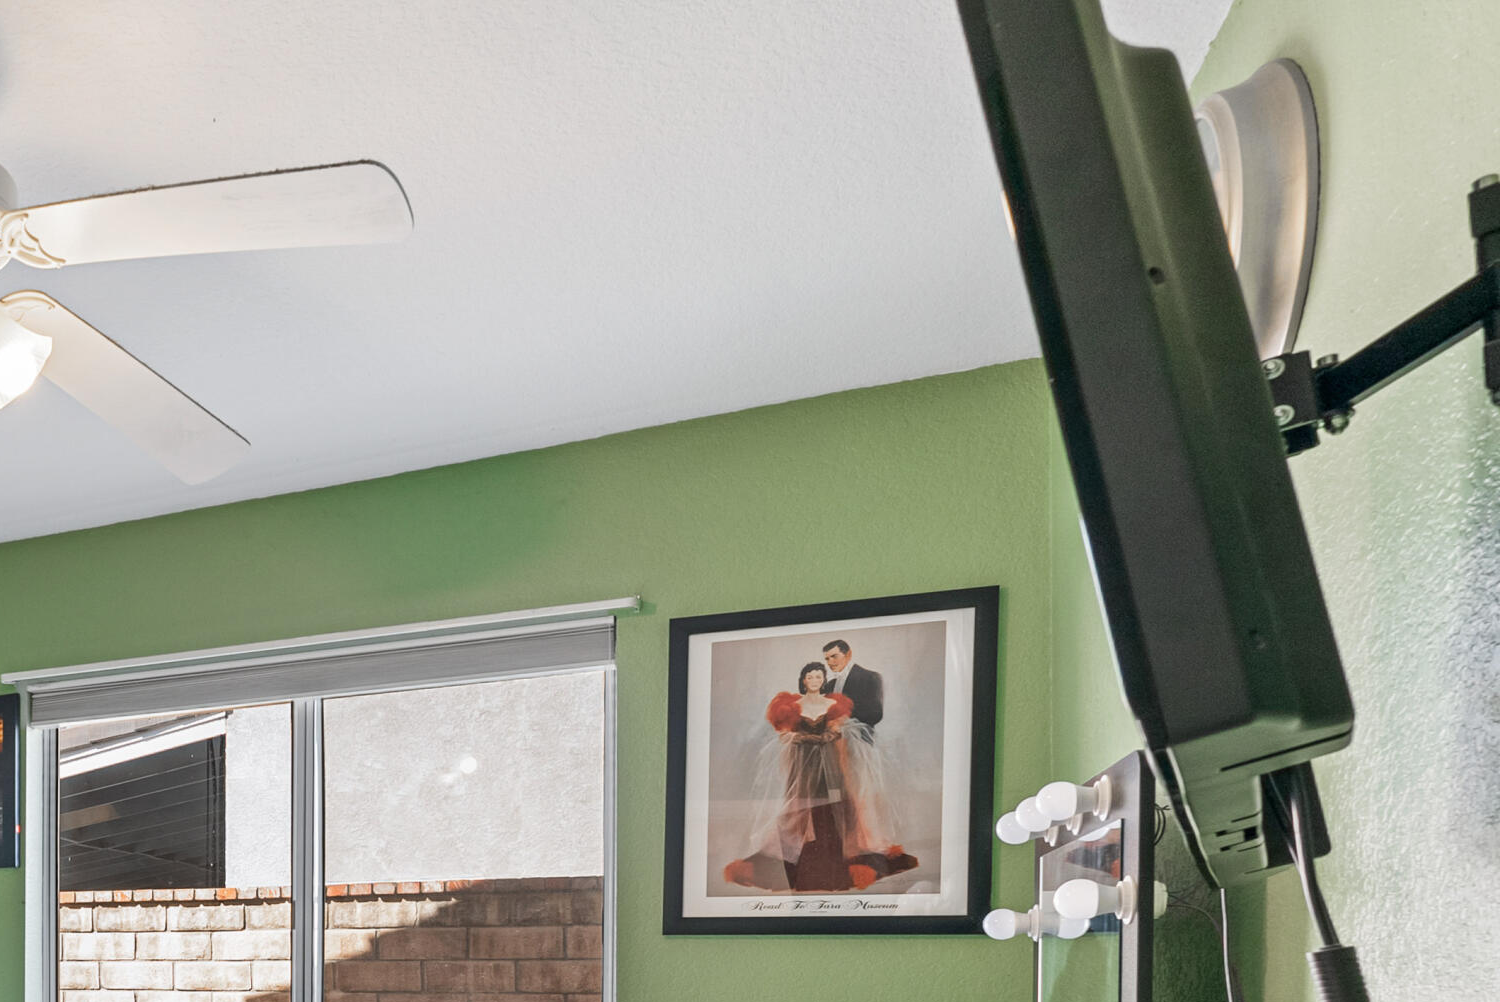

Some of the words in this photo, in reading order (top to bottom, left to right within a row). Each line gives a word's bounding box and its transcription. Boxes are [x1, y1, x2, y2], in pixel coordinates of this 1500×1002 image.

[749, 901, 783, 911] Road
[814, 900, 842, 911] Tara
[852, 899, 899, 911] Museum
